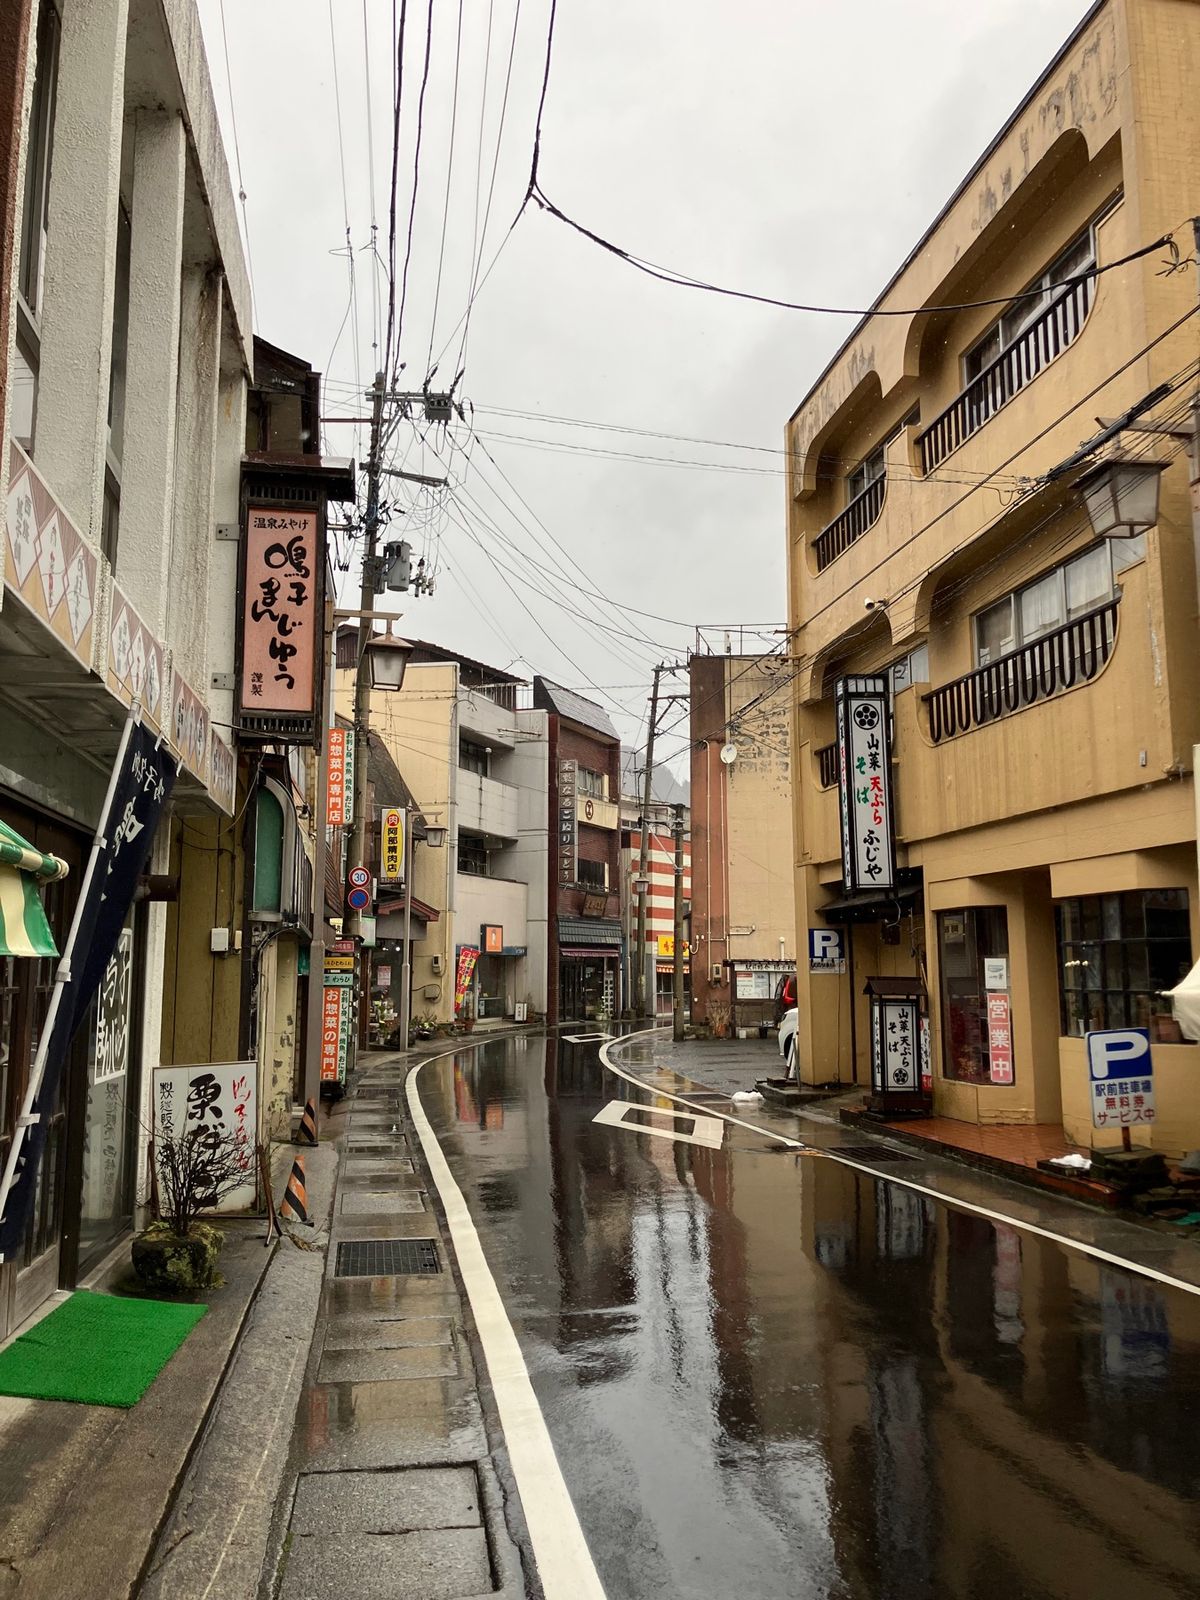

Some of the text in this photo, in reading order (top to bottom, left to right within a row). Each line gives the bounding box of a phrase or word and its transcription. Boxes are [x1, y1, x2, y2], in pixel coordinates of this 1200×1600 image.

[254, 517, 309, 530] 温泉みやげ
[251, 671, 264, 697] 謹製
[329, 732, 342, 822] お惣菜の専門店
[856, 756, 870, 804] そば
[387, 827, 398, 872] 阿部精肉店
[863, 829, 883, 881] ふじや
[354, 873, 366, 882] 30
[888, 1022, 899, 1053] そば
[989, 999, 1010, 1077] 営業中
[1090, 1031, 1148, 1079] P
[1095, 1080, 1152, 1097] 駅前駐車場
[1105, 1095, 1145, 1109] 無料券
[1097, 1109, 1155, 1125] サービス中
